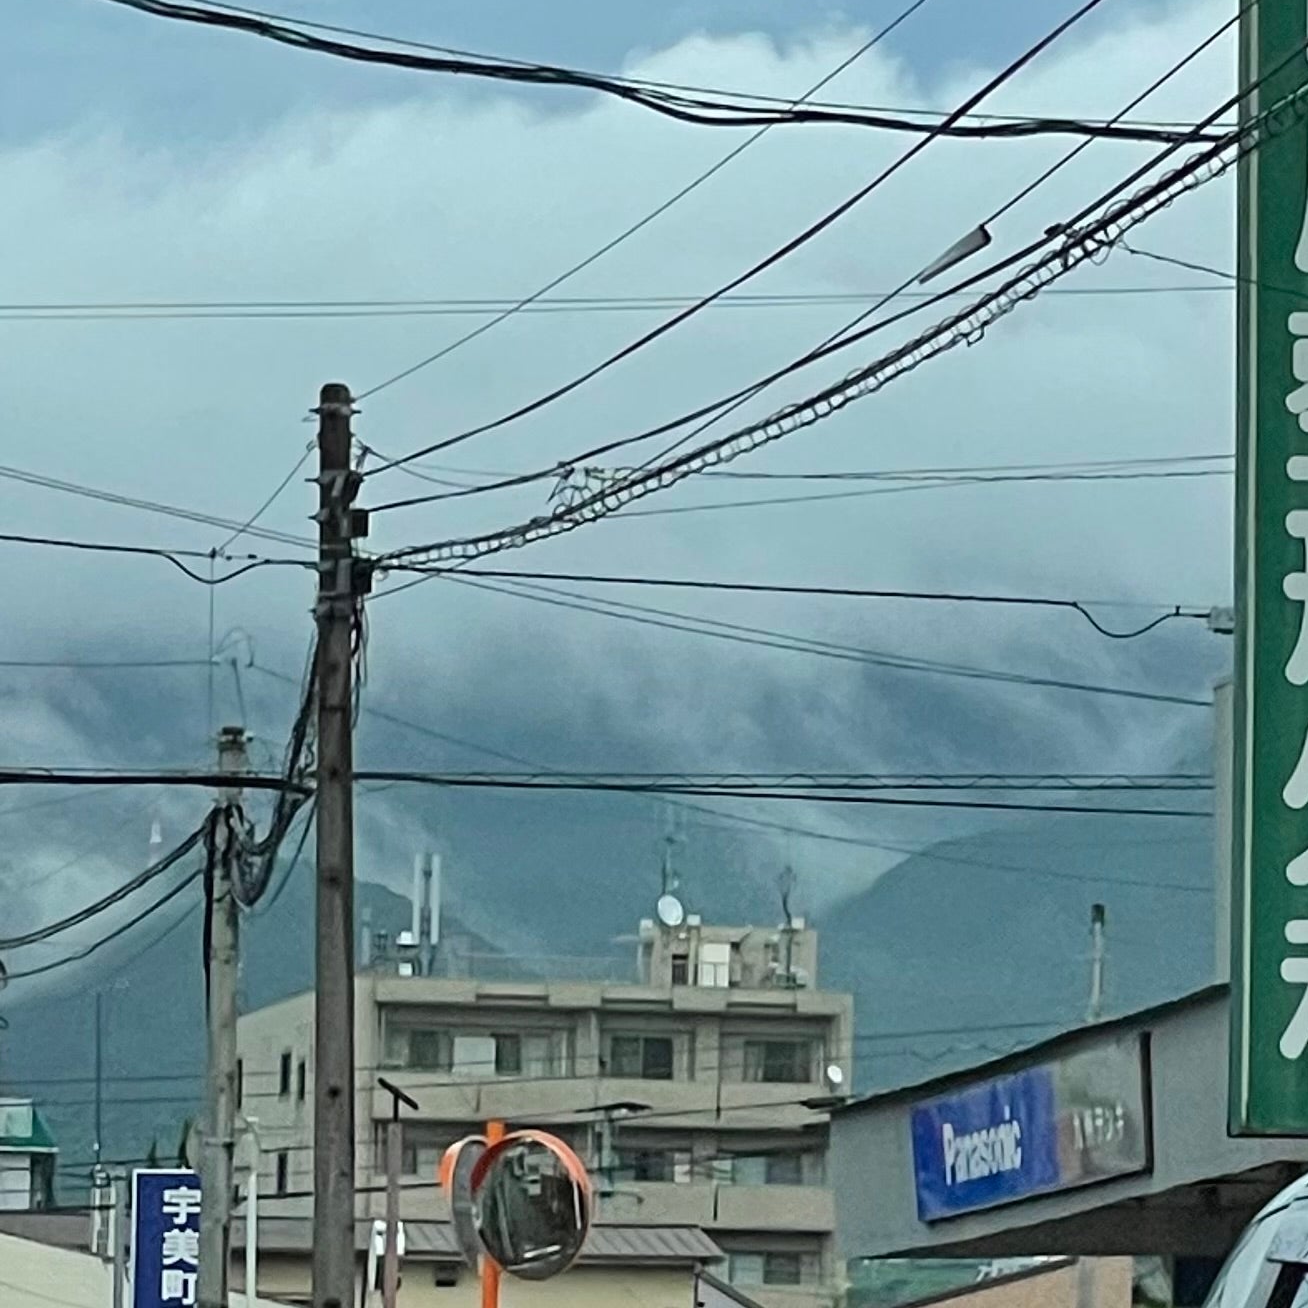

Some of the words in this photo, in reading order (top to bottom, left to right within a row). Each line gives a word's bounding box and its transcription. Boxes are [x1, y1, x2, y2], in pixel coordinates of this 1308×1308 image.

[942, 1105, 1023, 1187] Panasonic
[161, 1186, 202, 1306] 宇美町
